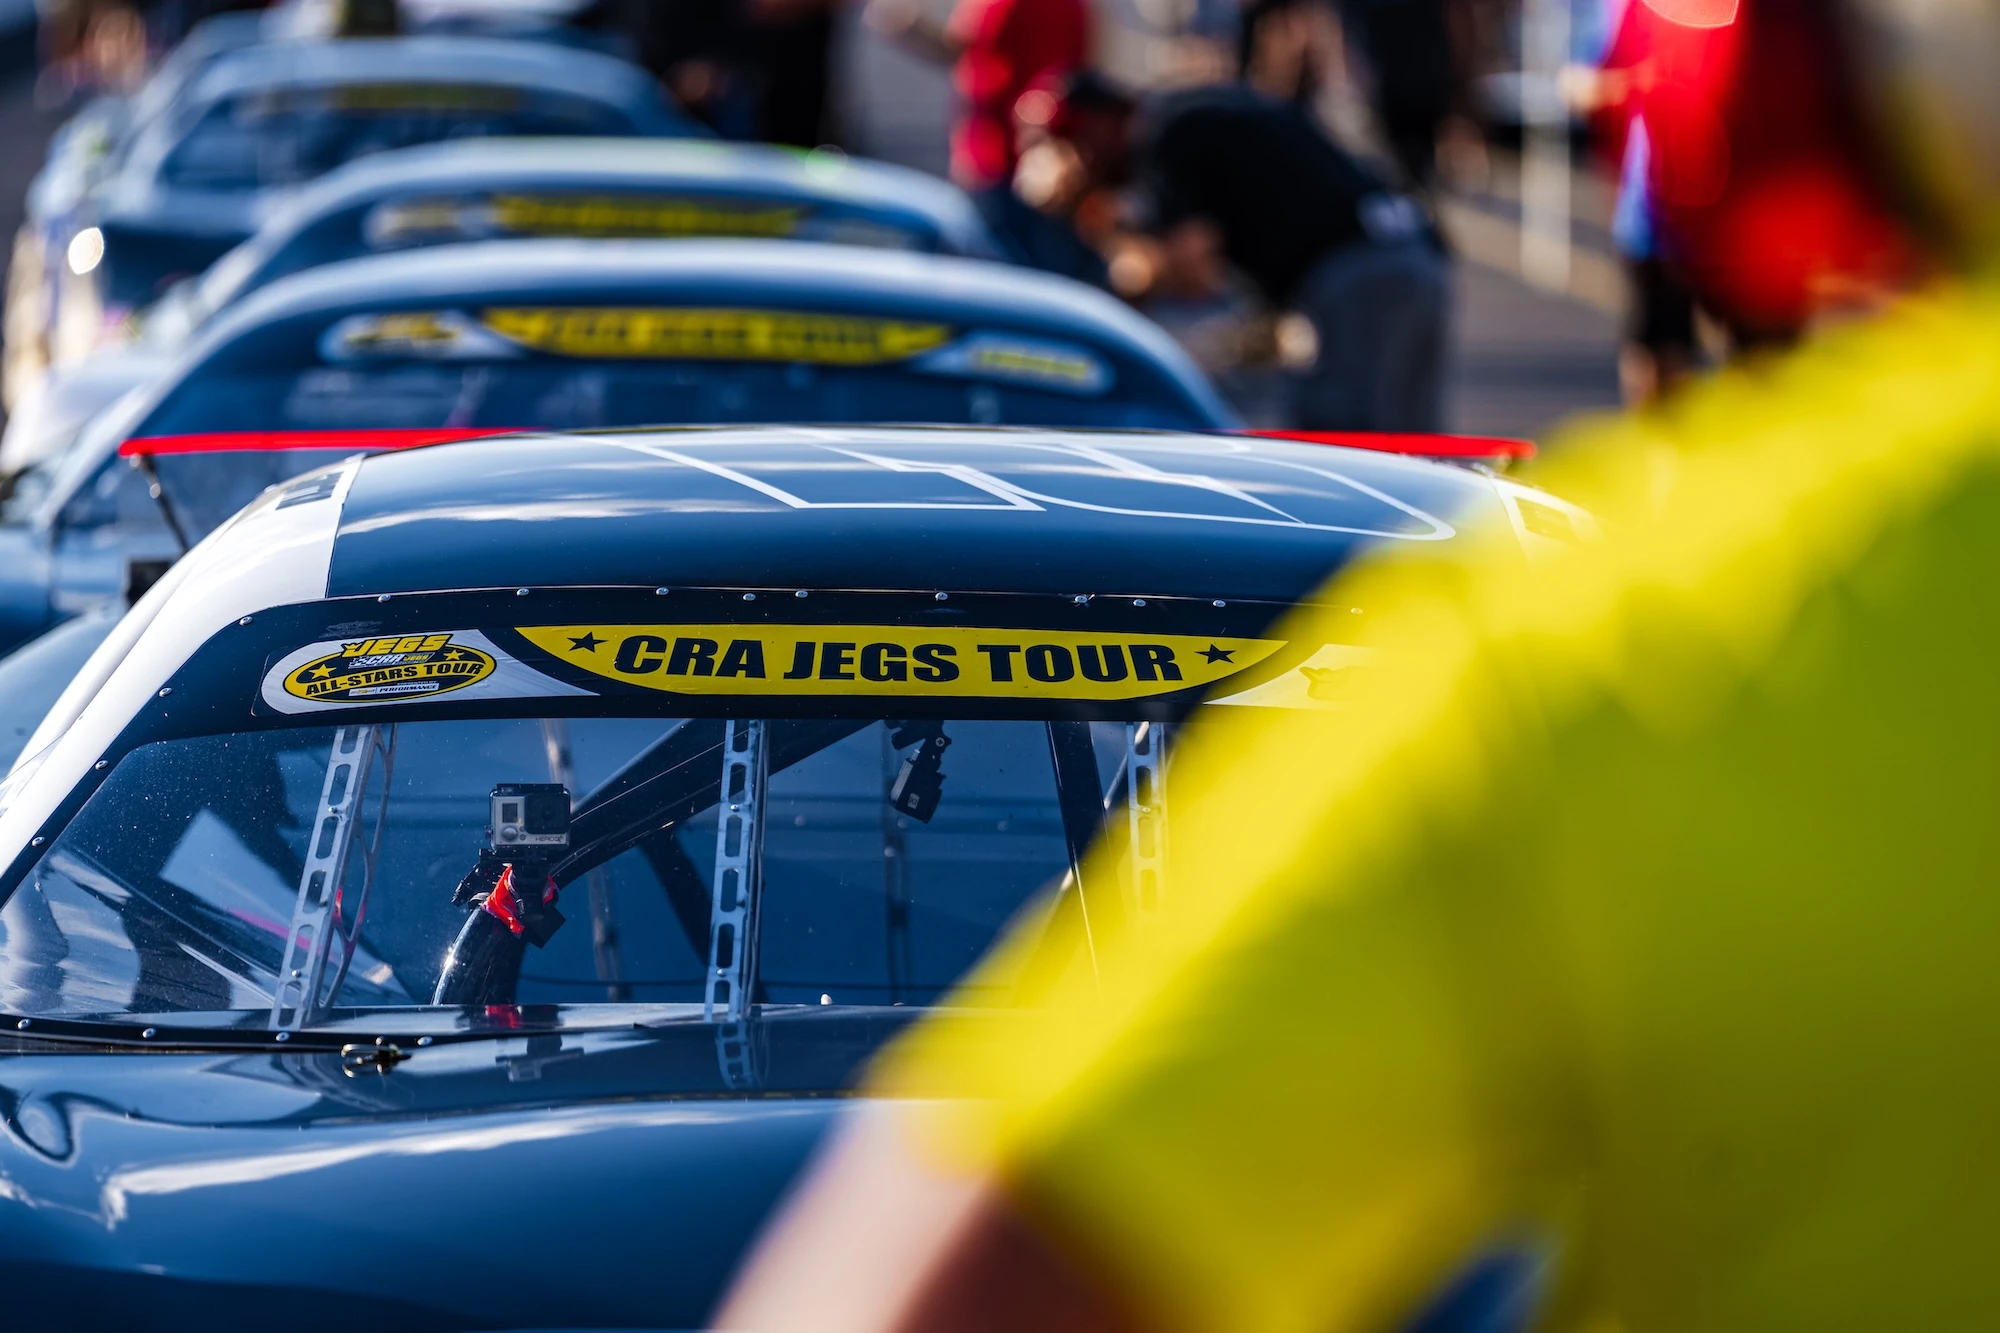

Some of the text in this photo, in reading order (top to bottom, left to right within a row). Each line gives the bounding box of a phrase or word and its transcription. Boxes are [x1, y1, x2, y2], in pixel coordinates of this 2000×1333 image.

[344, 634, 452, 657] JEGS
[615, 635, 1183, 682] CRA JEGS TOUR
[305, 662, 484, 696] ALL-STARS TOUR
[379, 683, 438, 693] PERFORMANCE
